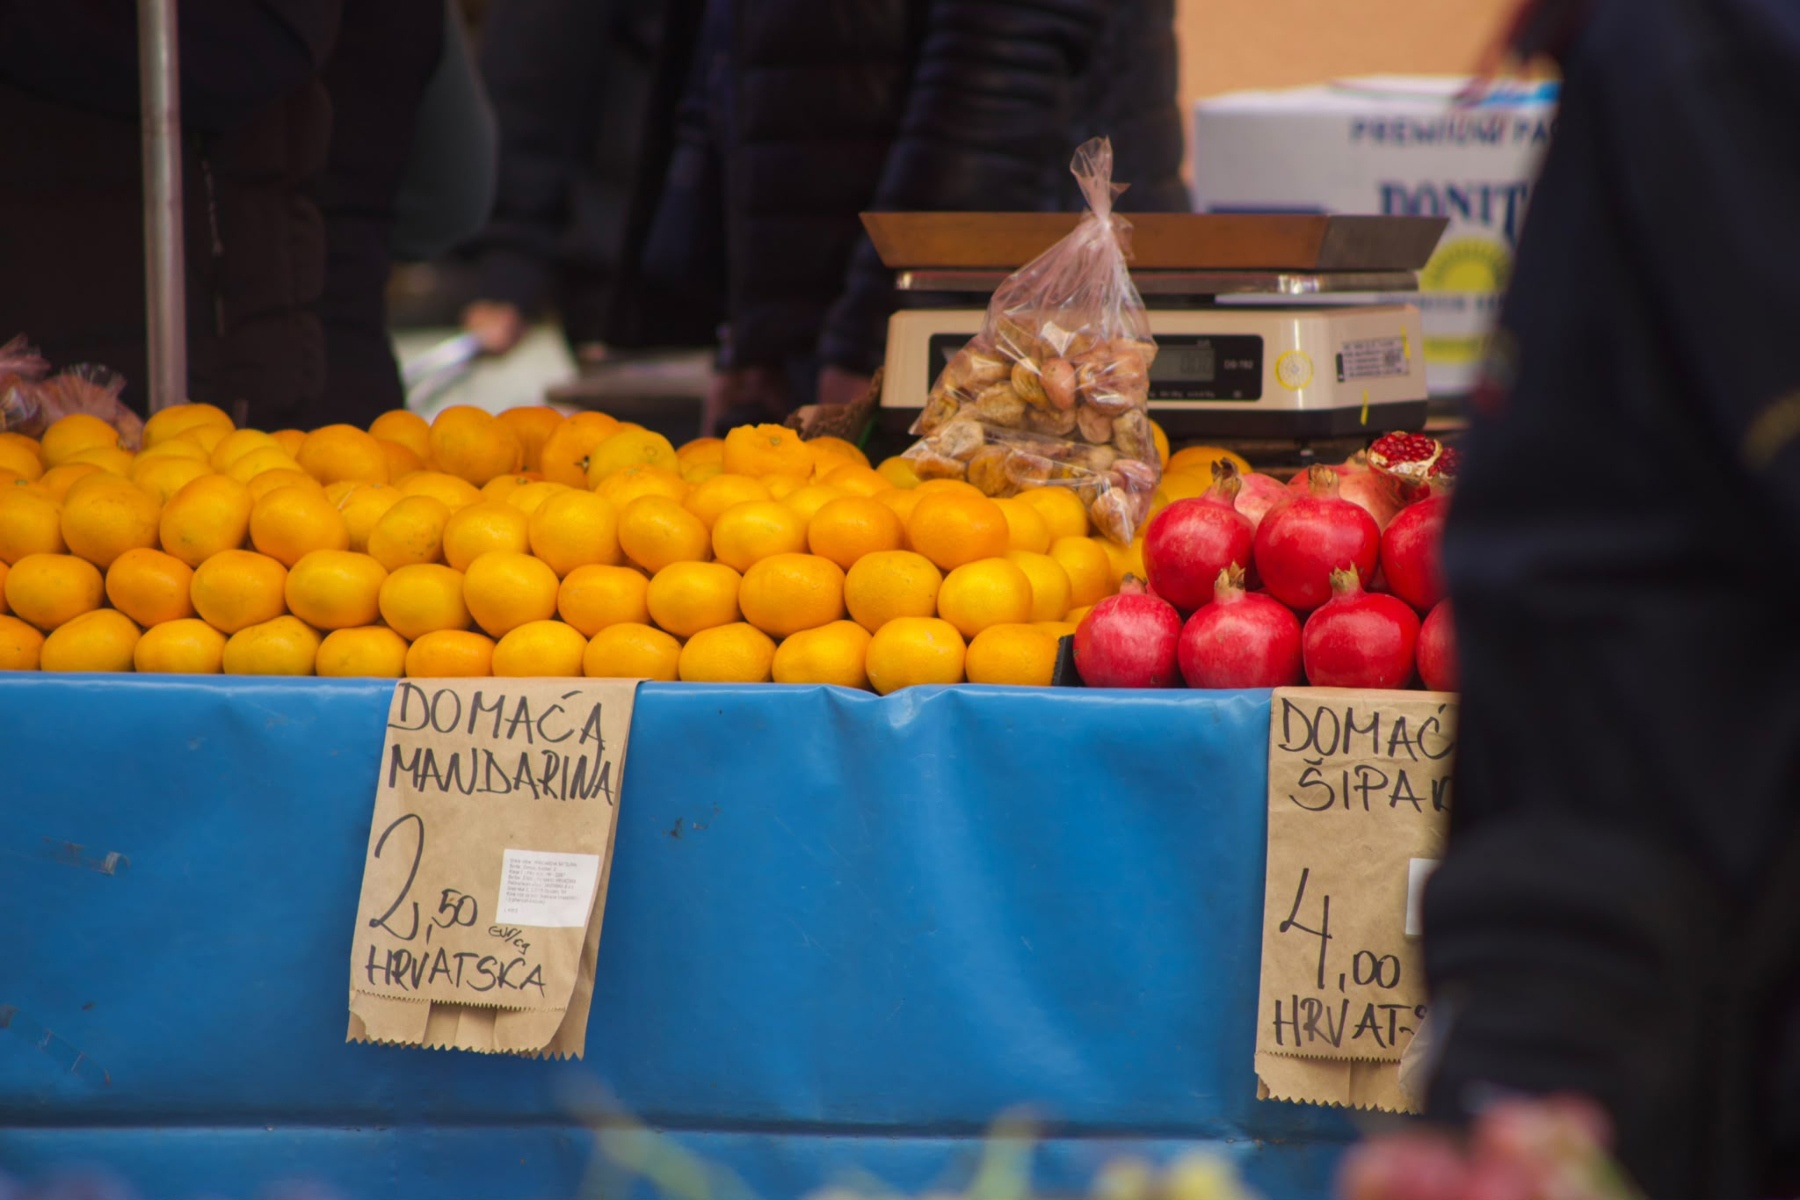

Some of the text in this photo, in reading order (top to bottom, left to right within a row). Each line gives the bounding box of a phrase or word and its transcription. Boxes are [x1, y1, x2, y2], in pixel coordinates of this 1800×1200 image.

[1352, 117, 1552, 145] PREMIUM PA
[1380, 181, 1528, 246] DONIT
[387, 681, 605, 750] DOMAĆA
[1278, 697, 1455, 761] DOMAĆ
[388, 744, 614, 806] MANDARINA
[369, 813, 477, 944] 2,50
[1279, 867, 1401, 990] 4,00
[1273, 994, 1428, 1049] HRVATS
